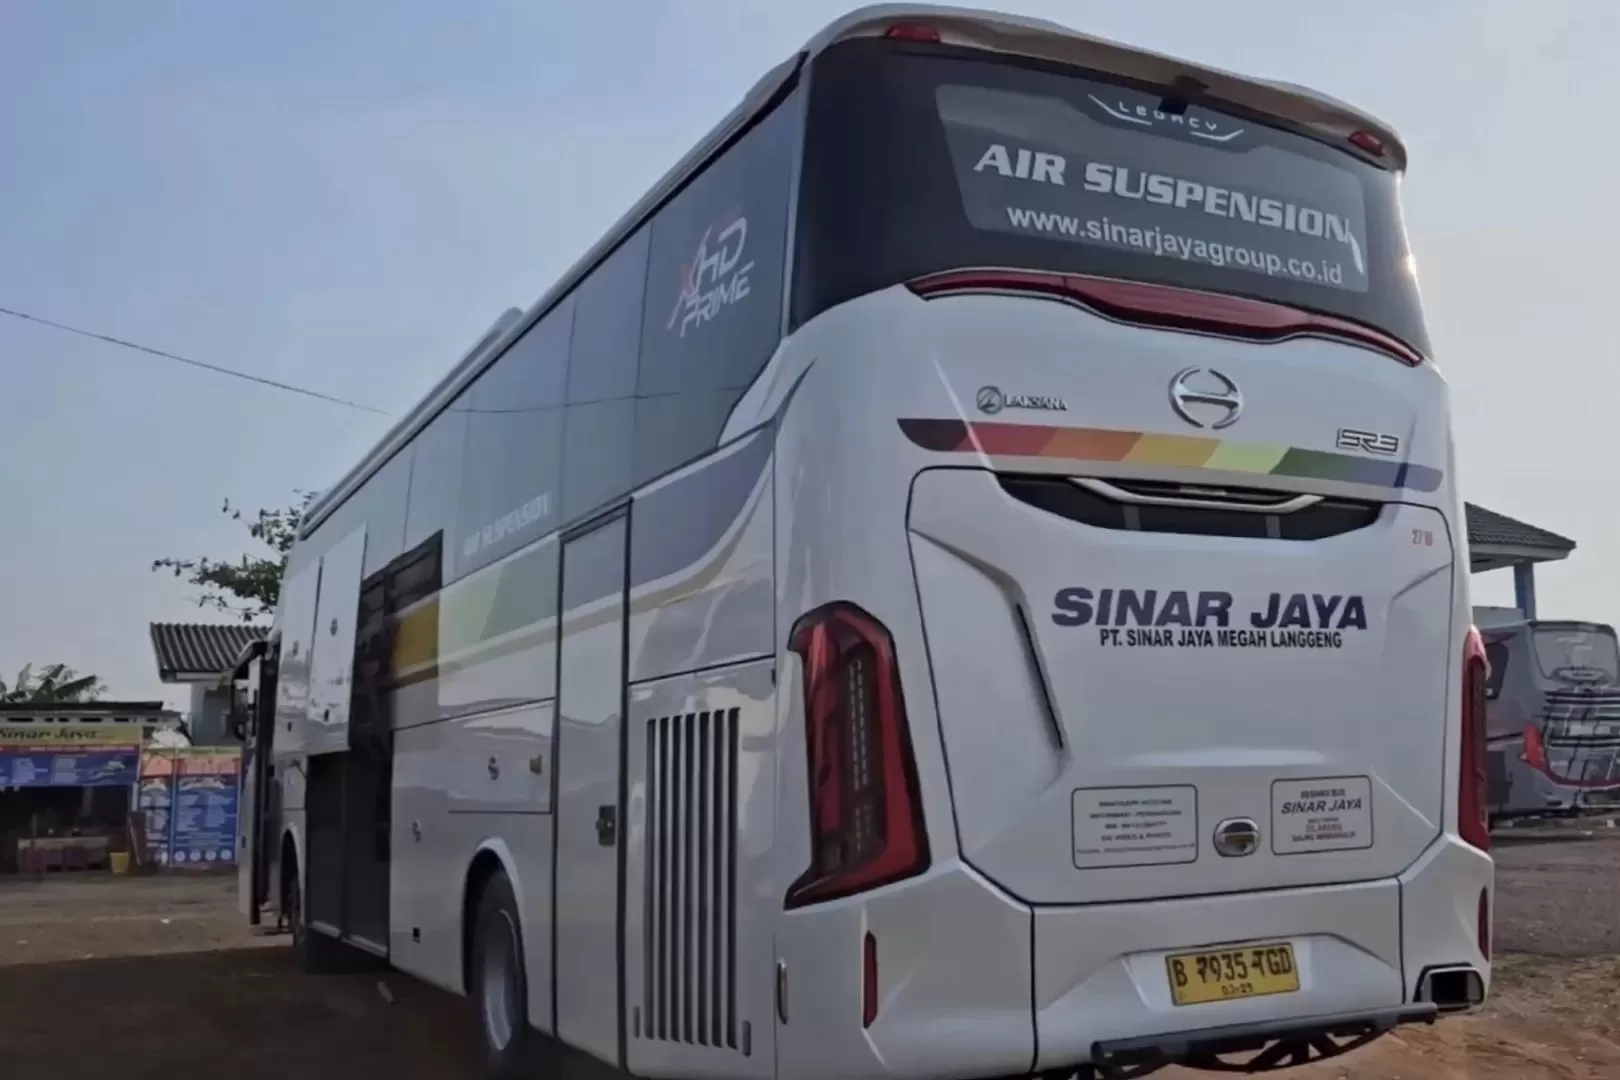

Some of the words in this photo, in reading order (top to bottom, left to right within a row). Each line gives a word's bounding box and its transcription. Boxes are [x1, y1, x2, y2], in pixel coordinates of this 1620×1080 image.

[1118, 101, 1217, 131] LEGACY
[973, 144, 1066, 186] AIR
[1083, 162, 1350, 245] SUSPENSION
[1006, 206, 1343, 284] www.sinarjayagroup.co.id
[1003, 394, 1068, 412] LAKSANA
[1051, 587, 1233, 627] SINAR
[1250, 592, 1367, 630] JAYA
[1100, 629, 1122, 646] PT.
[1126, 629, 1173, 647] SINAR
[1177, 629, 1214, 647] JAYA
[1217, 630, 1267, 647] MEGAH
[1271, 631, 1342, 648] LANGGENG
[1281, 800, 1327, 814] SINAR
[1328, 798, 1362, 812] JAYA
[1172, 959, 1188, 987] B
[1196, 951, 1248, 983] 7935
